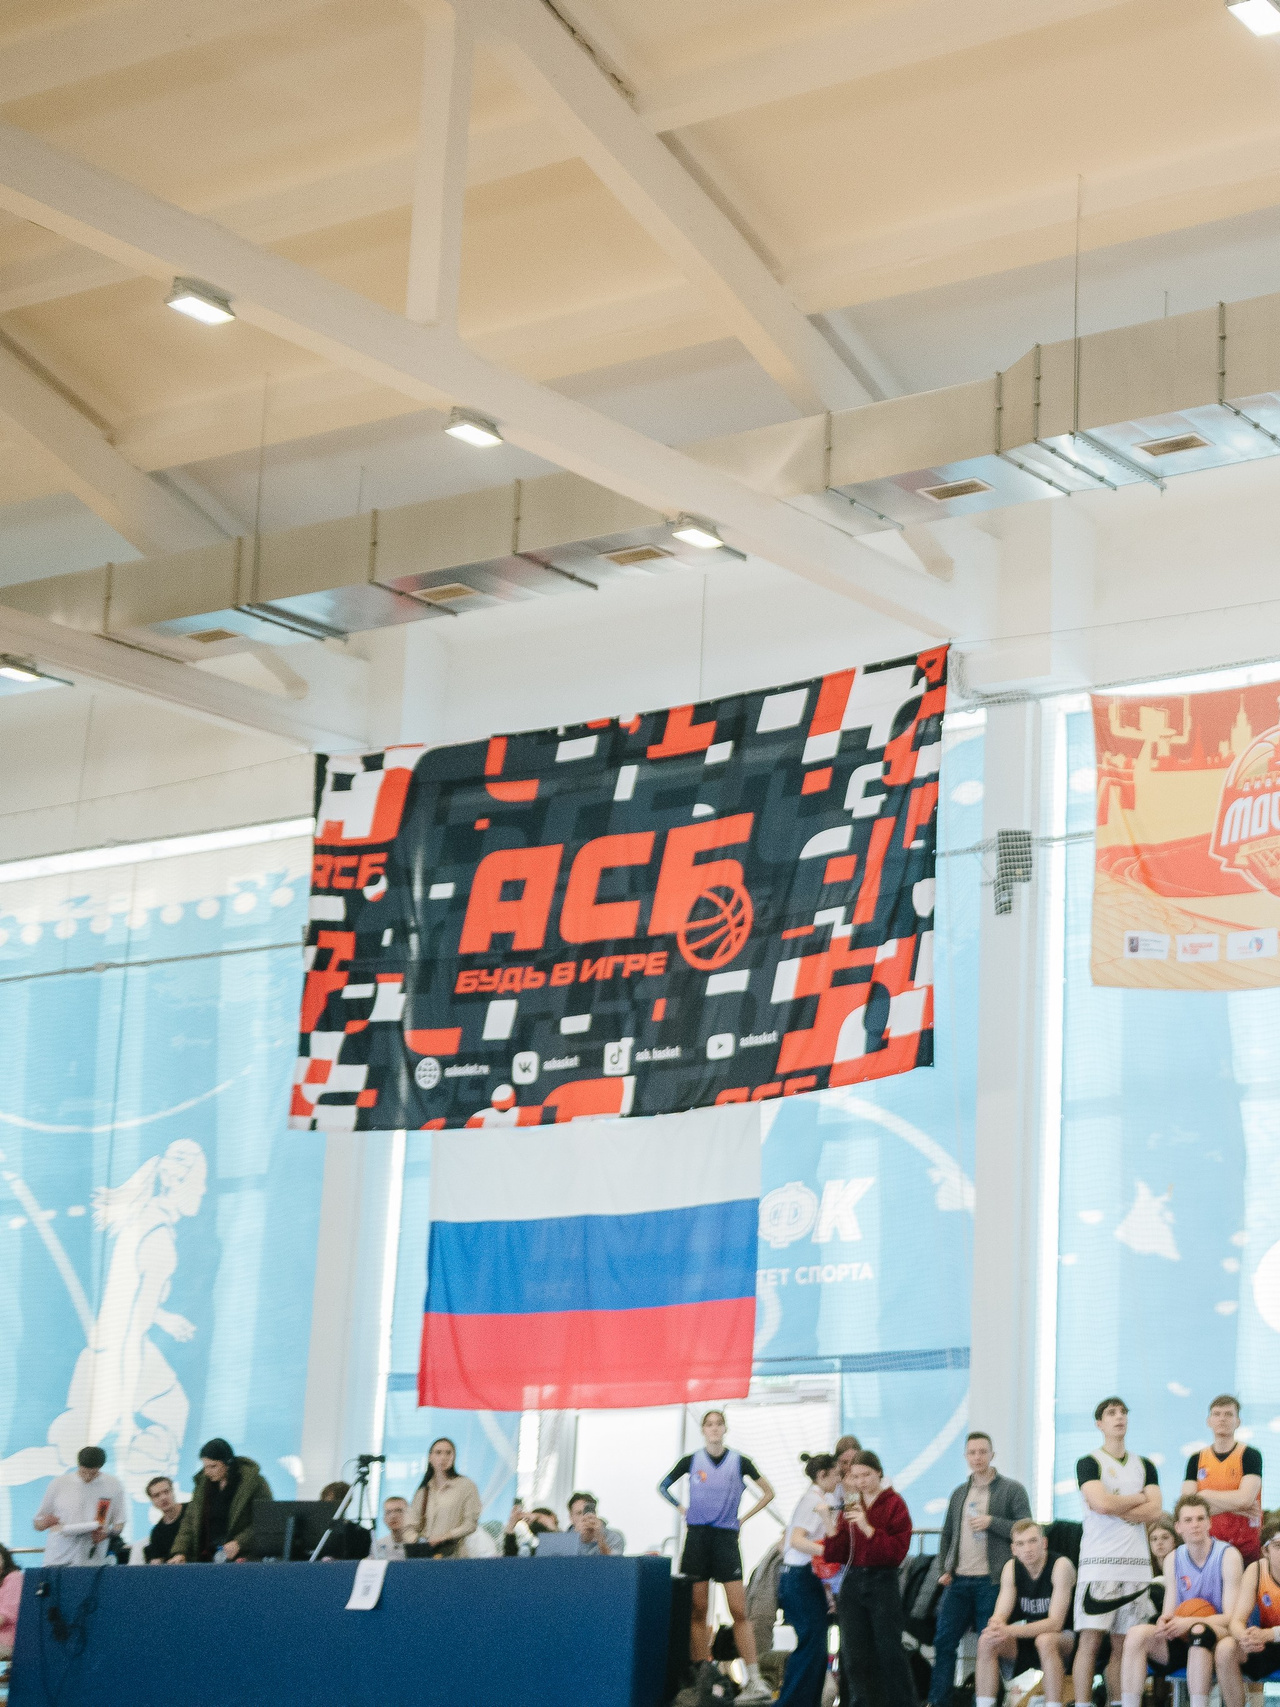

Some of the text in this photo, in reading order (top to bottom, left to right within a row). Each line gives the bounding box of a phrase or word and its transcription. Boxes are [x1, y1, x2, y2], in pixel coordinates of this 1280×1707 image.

[458, 811, 754, 955] АСБ
[454, 950, 670, 995] БУДЬ В ИГРЕ
[795, 1262, 875, 1285] СПОРТА
